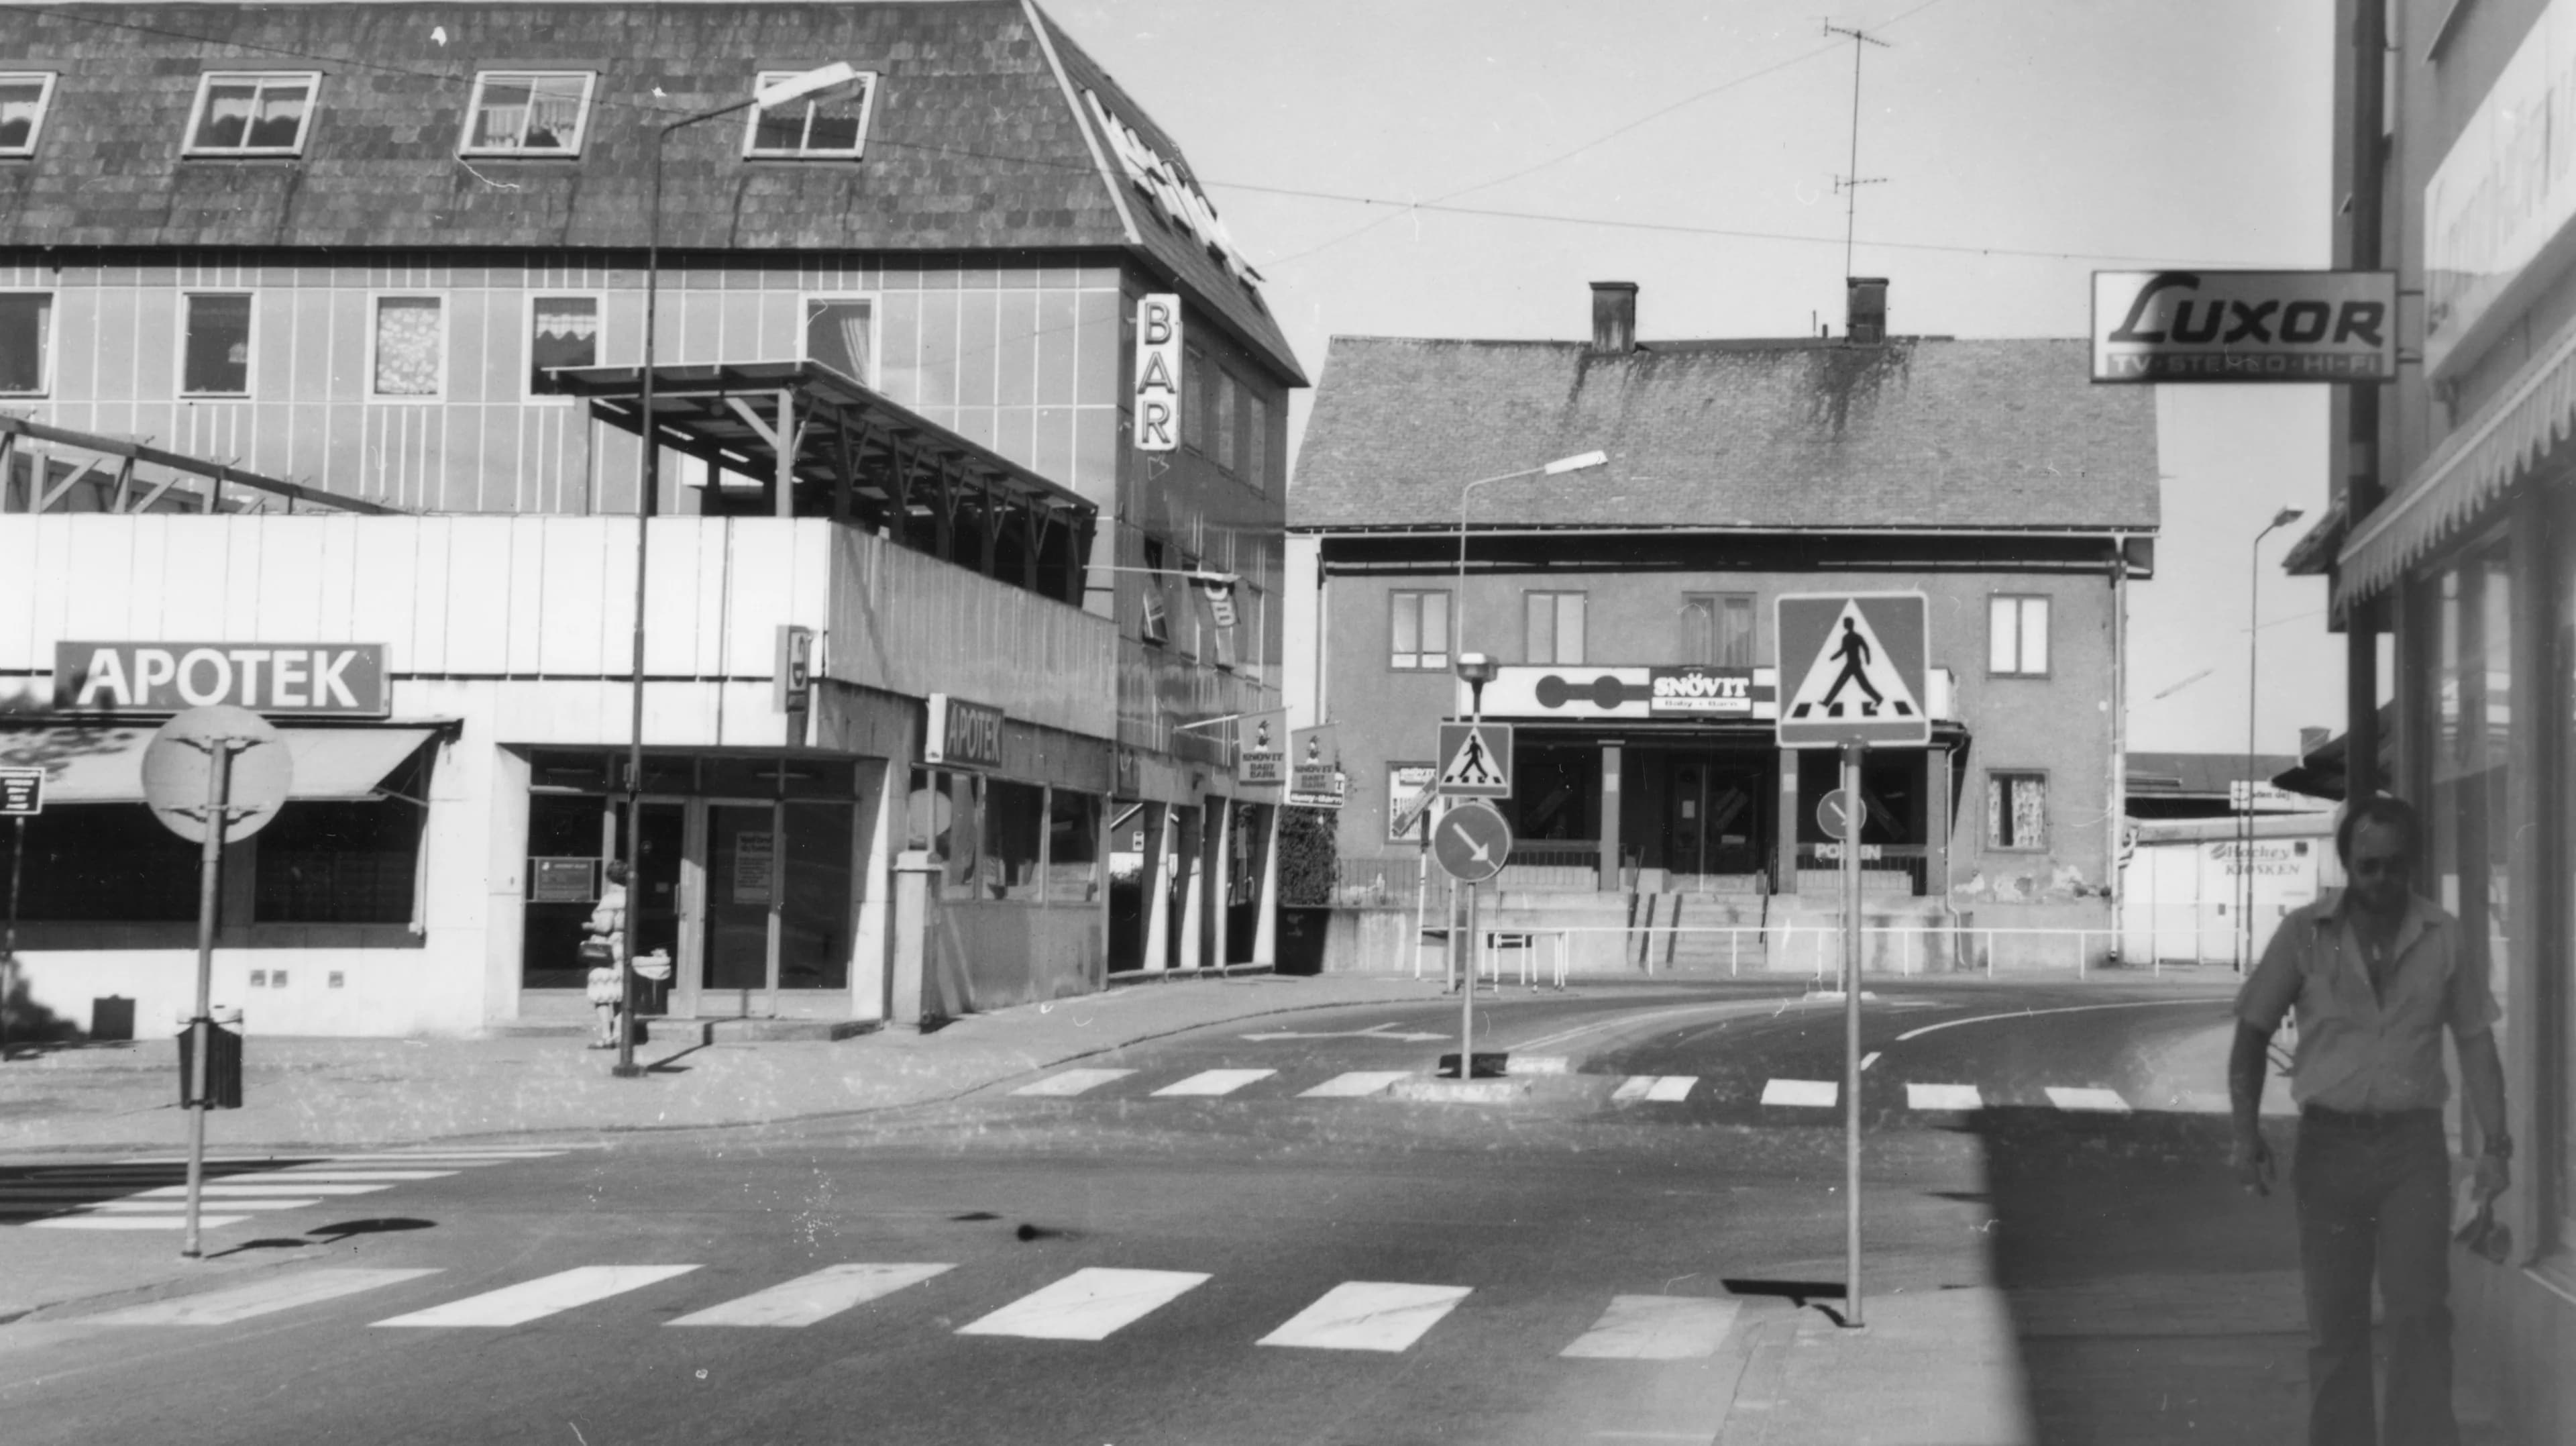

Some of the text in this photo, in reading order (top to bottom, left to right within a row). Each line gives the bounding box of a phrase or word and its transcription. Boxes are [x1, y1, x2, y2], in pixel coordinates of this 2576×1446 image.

[1137, 302, 1175, 444] BAR
[2112, 355, 2151, 373] TV
[2303, 356, 2377, 373] HI-FI
[76, 648, 360, 707] APOTEK
[1653, 672, 1750, 697] SNÖVIT
[946, 704, 1000, 762] APOTEK
[1815, 843, 1881, 860] POEN
